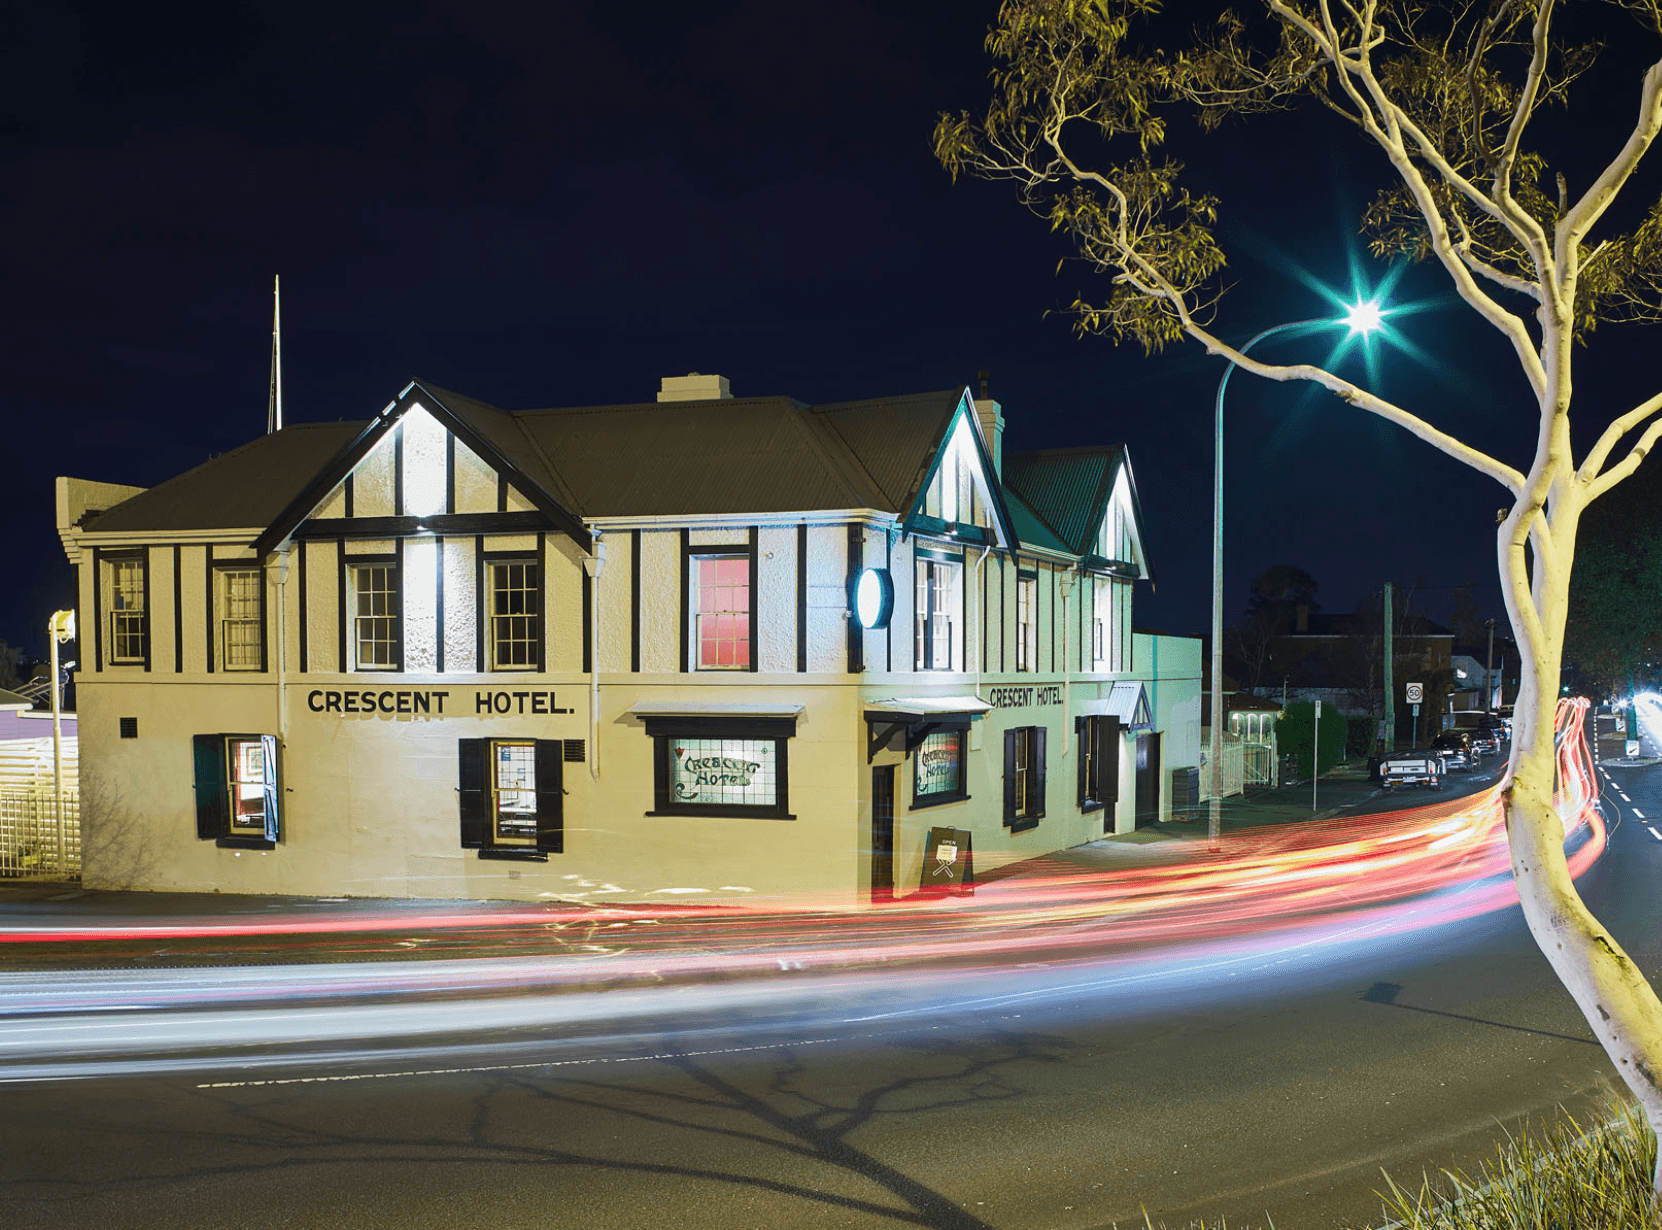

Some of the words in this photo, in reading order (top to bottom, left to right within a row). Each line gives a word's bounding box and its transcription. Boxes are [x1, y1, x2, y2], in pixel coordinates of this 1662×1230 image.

[307, 690, 449, 713] CRESCENT
[475, 691, 575, 715] HOTEL.
[989, 688, 1034, 708] CRESCENT
[1036, 686, 1064, 706] HOTEL.
[1409, 689, 1420, 697] 50
